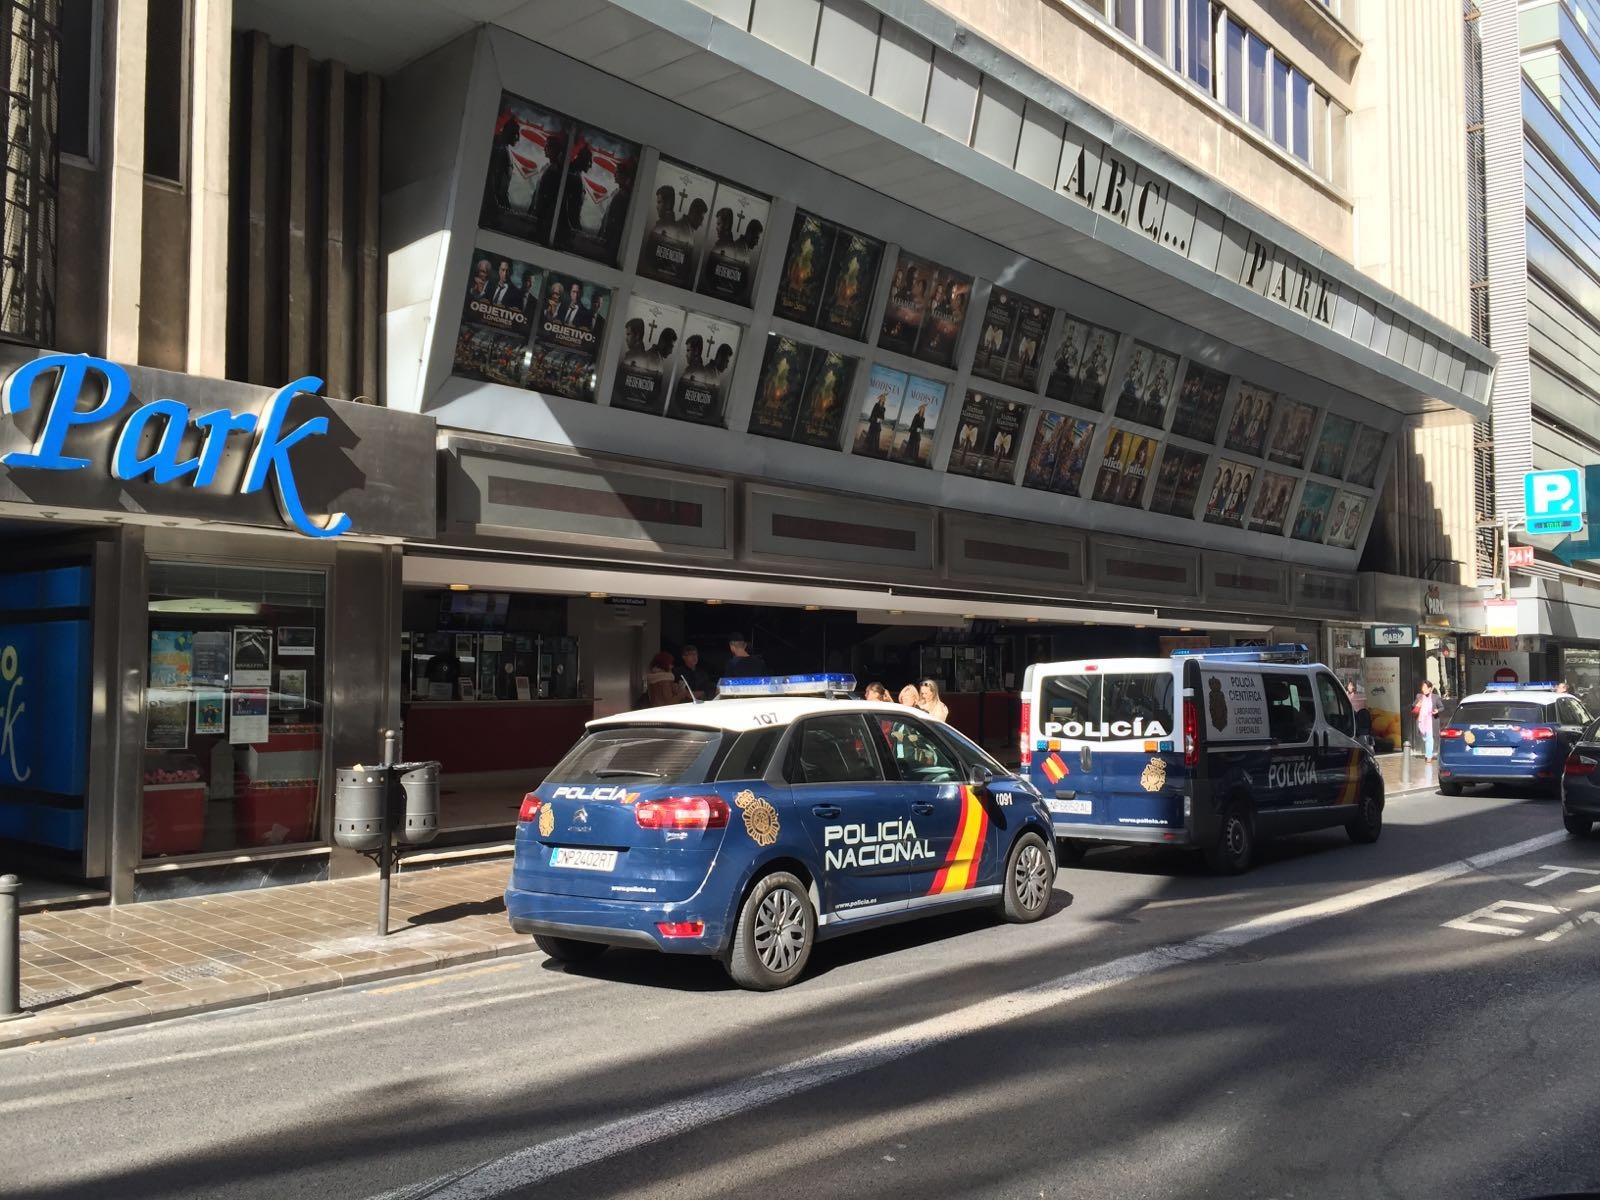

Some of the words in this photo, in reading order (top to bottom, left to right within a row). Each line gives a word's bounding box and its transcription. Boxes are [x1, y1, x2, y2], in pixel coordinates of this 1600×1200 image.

[1246, 241, 1332, 324] PARK
[470, 301, 528, 325] OBJETIVO:
[483, 313, 513, 326] LONDRES
[544, 322, 596, 343] OBJETIVO:
[556, 333, 582, 345] LONDRES
[0, 353, 353, 538] Park
[1533, 474, 1571, 513] P
[1509, 550, 1523, 563] 24
[1524, 549, 1533, 561] H
[753, 712, 778, 726] 107
[1045, 717, 1168, 737] POLICÍA
[1268, 755, 1318, 789] POLICÍA
[552, 786, 628, 801] POLICÍA
[999, 792, 1013, 806] 091
[824, 817, 916, 846] POLICÍA
[824, 840, 935, 871] NACIONAL
[834, 898, 877, 909] www.policia.es
